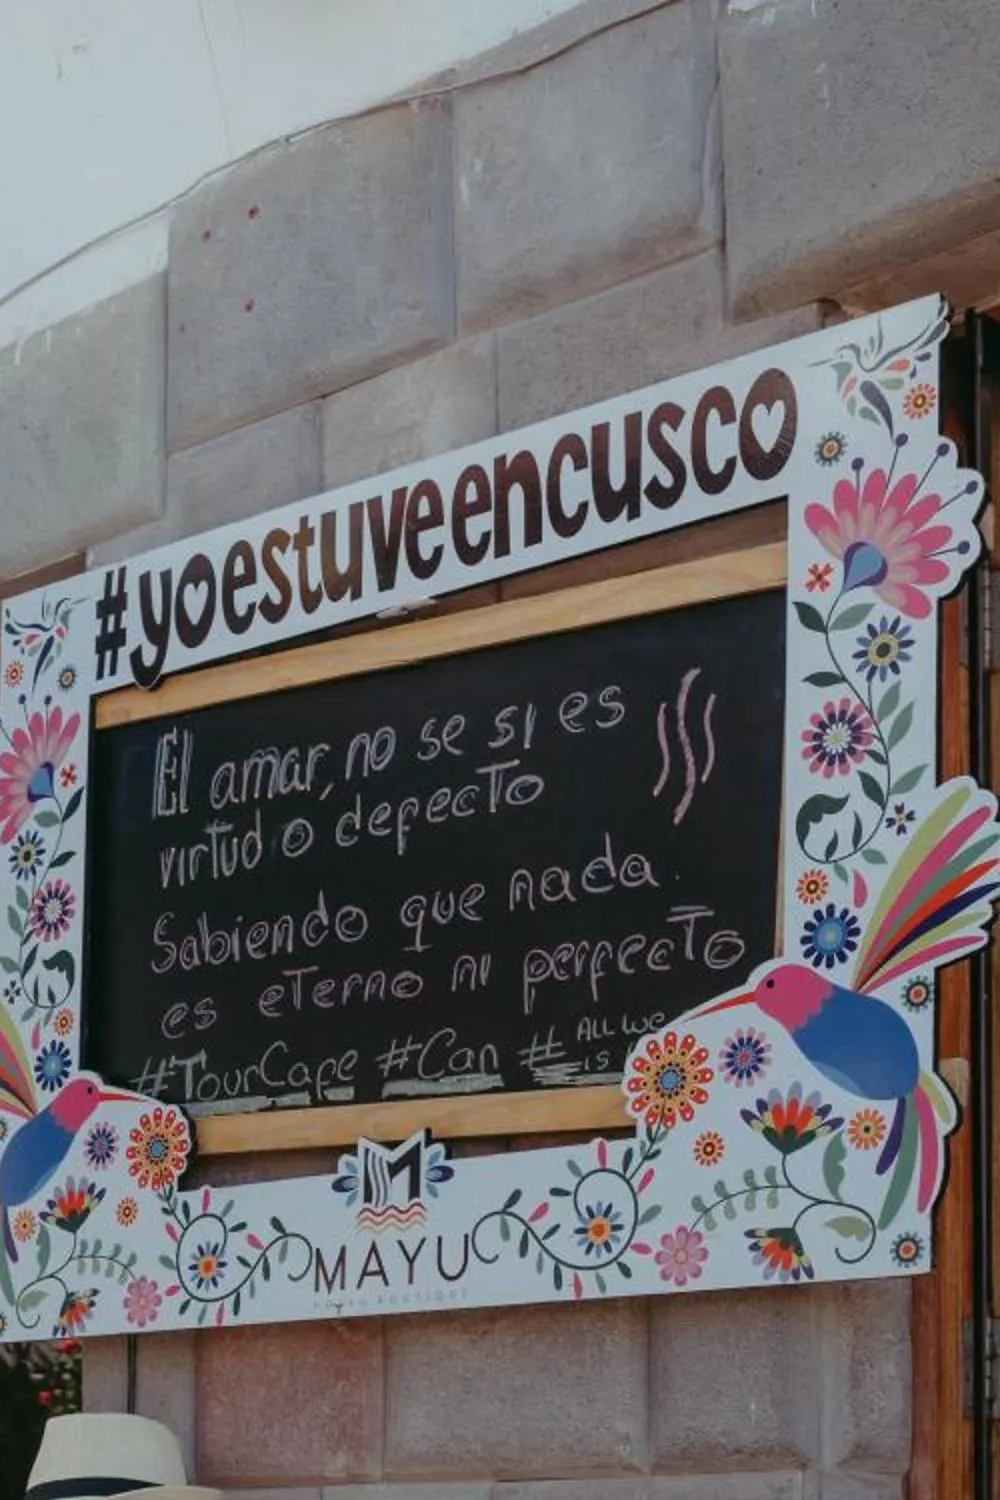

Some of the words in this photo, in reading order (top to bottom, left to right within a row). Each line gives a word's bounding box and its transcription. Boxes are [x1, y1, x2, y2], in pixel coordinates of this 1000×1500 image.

[94, 366, 798, 691] #yoestuveencusco
[152, 725, 195, 819] El
[344, 725, 397, 781] no
[416, 713, 467, 761] se
[559, 684, 626, 733] es
[281, 817, 314, 858] o
[151, 888, 369, 974] Sabiendo
[399, 881, 487, 953] que
[161, 997, 218, 1039] es
[377, 1027, 499, 1080] #Can
[313, 1232, 470, 1294] MAYU
